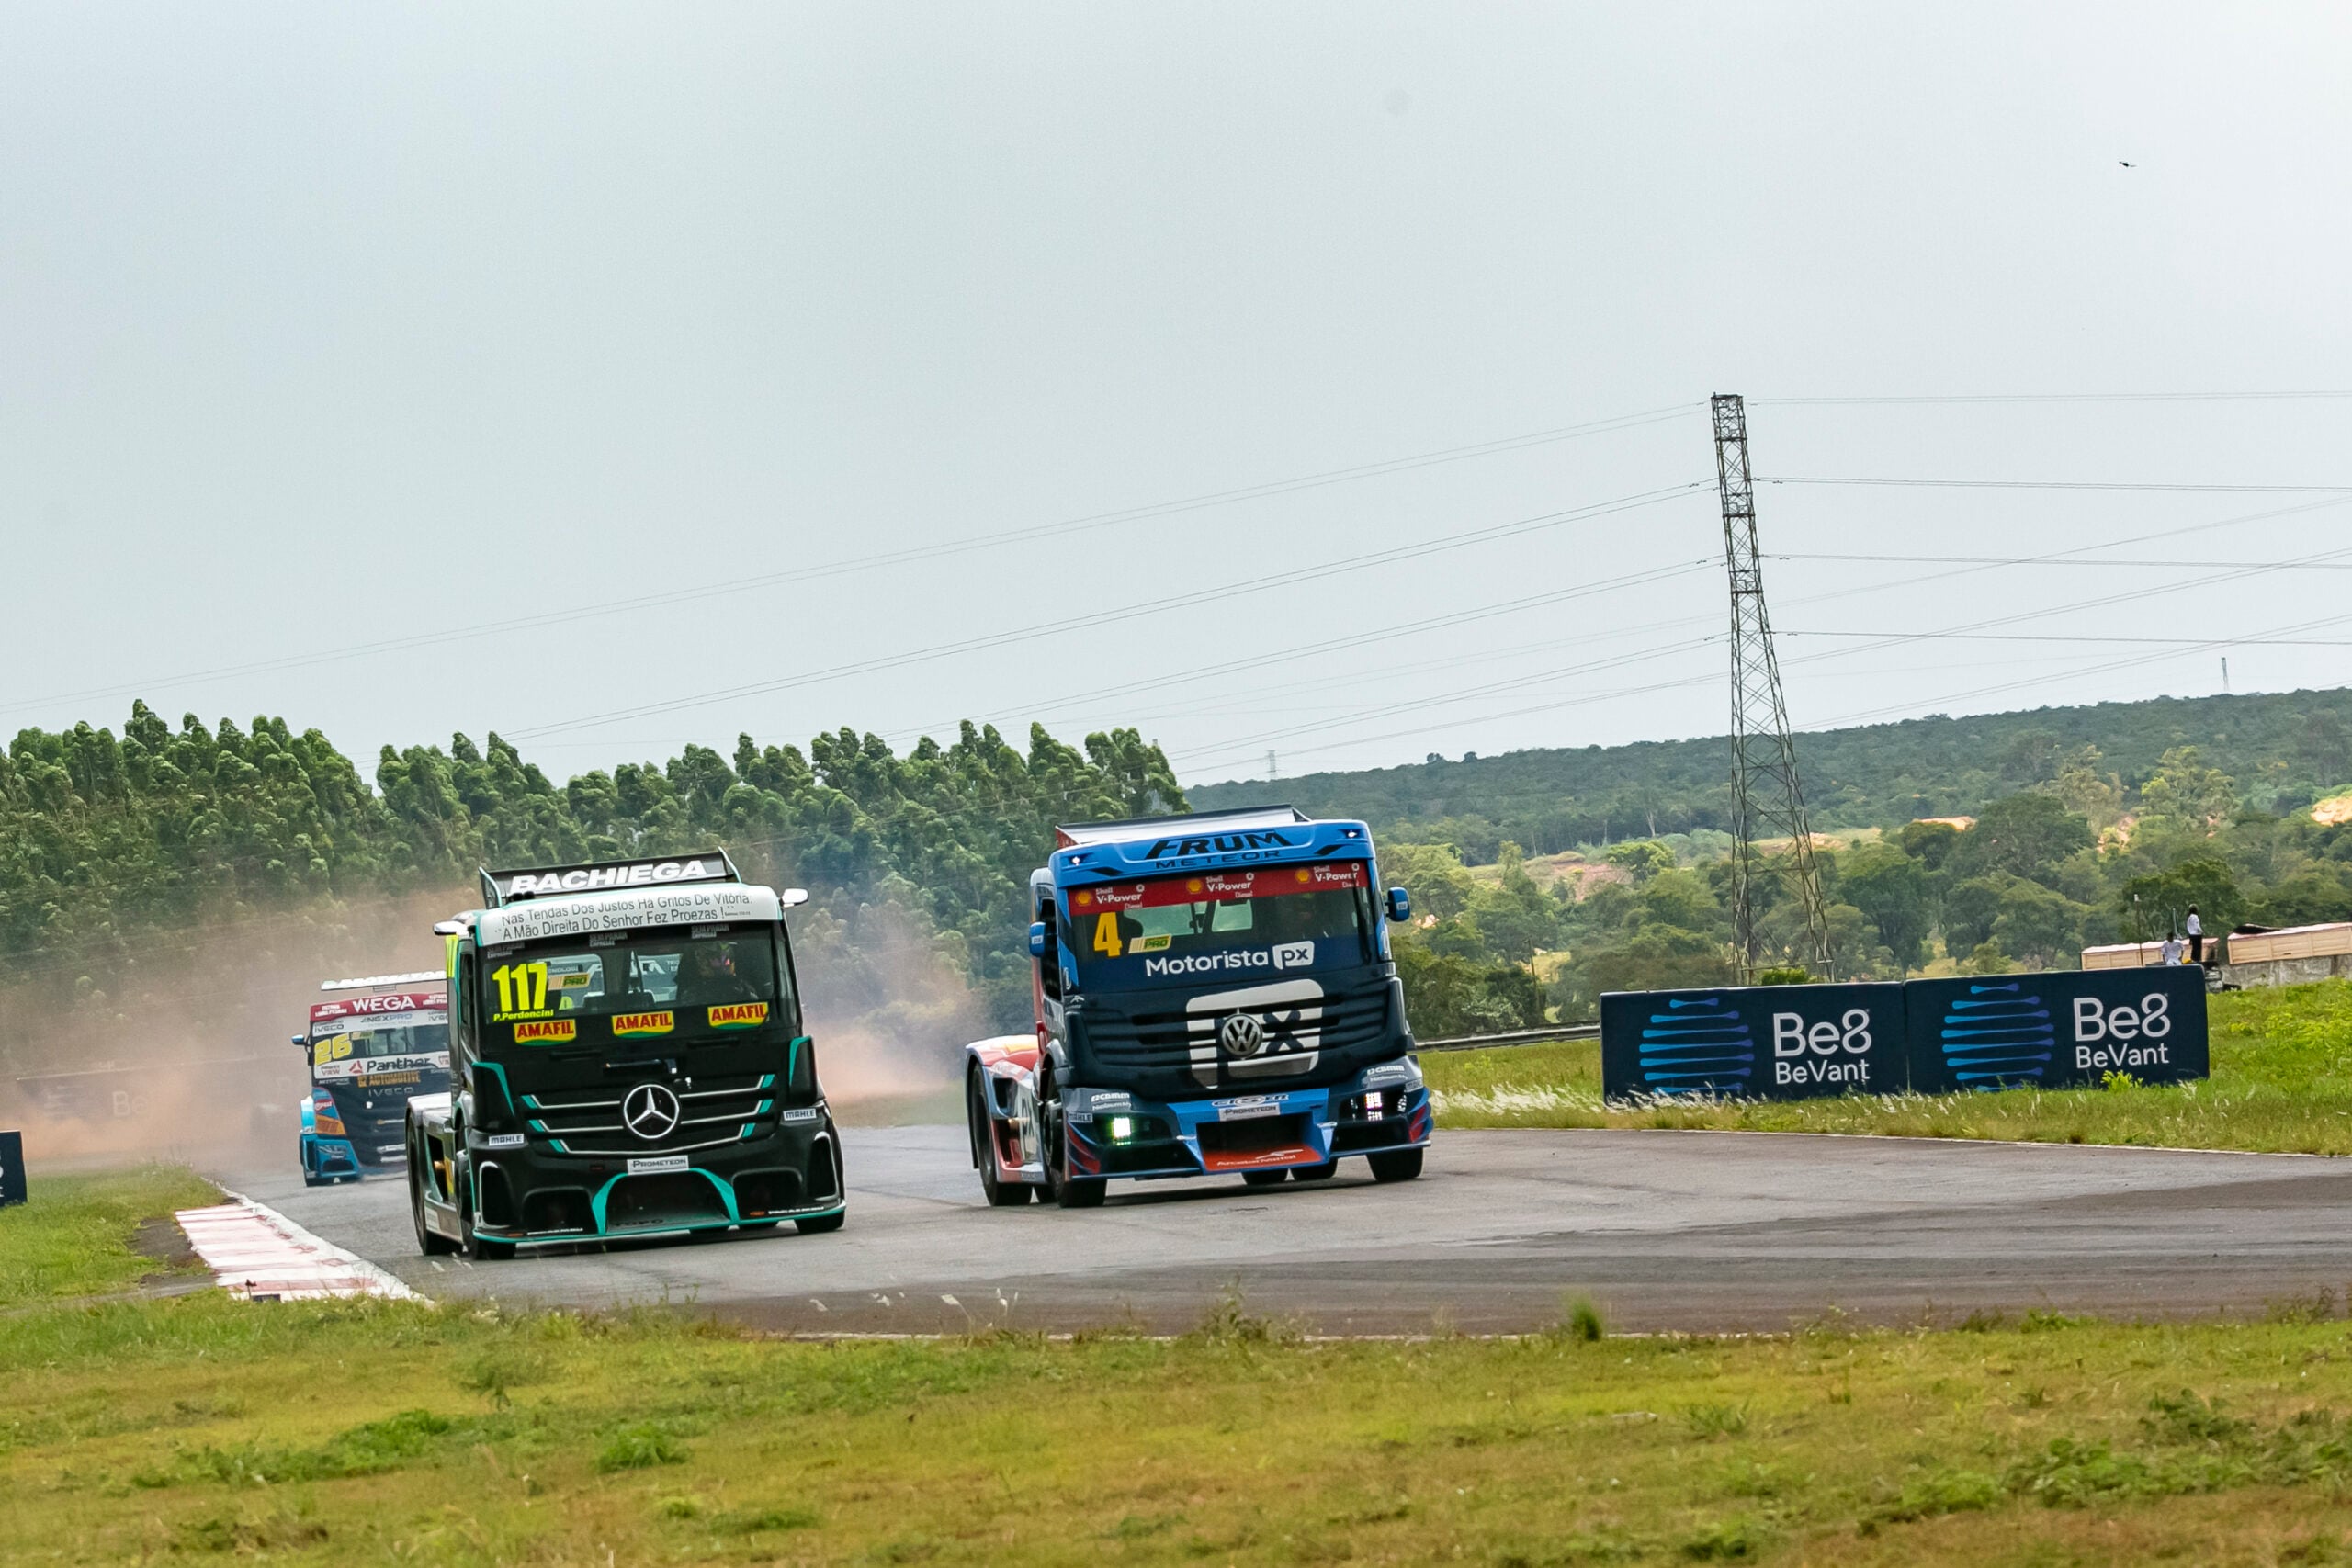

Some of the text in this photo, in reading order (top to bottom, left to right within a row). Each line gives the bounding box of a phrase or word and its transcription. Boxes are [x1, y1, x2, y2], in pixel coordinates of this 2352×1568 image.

[1145, 832, 1294, 860] FRUM
[1156, 851, 1280, 868] METEOR
[509, 860, 707, 896] BACHIEGA
[1315, 872, 1358, 882] V-Power
[1206, 882, 1252, 892] V-Power
[1096, 893, 1142, 904] V-Power
[502, 913, 525, 926] Nas
[527, 907, 569, 921] Tendas
[571, 903, 595, 915] Dos
[598, 899, 635, 913] Justos
[657, 895, 692, 908] Gritos
[695, 894, 710, 906] De
[514, 924, 539, 939] Mão
[542, 919, 580, 935] Direita
[582, 917, 598, 929] Do
[602, 913, 644, 929] Senhor
[646, 910, 669, 924] Fez
[671, 908, 718, 922] Proezas
[1094, 911, 1122, 957] 4
[1144, 939, 1168, 949] PRO
[1146, 946, 1309, 976] Motorista px
[492, 961, 548, 1012] 117
[563, 976, 588, 986] PRO
[353, 996, 416, 1013] WEGA
[711, 1004, 766, 1021] AMAFIL
[616, 1012, 673, 1031] AMAFIL
[2074, 993, 2171, 1042] Be8
[315, 1024, 345, 1032] IVECO
[516, 1021, 574, 1038] AMAFIL
[1773, 1009, 1872, 1056] Be8
[314, 1032, 353, 1066] 26
[2075, 1043, 2169, 1068] BeVant
[368, 1057, 432, 1073] Panther
[1775, 1058, 1871, 1084] BeVant
[368, 1087, 413, 1097] IVECO
[786, 1110, 815, 1119] MAHLE
[491, 1135, 523, 1145] MAHLE
[632, 1158, 686, 1168] PROMETEON
